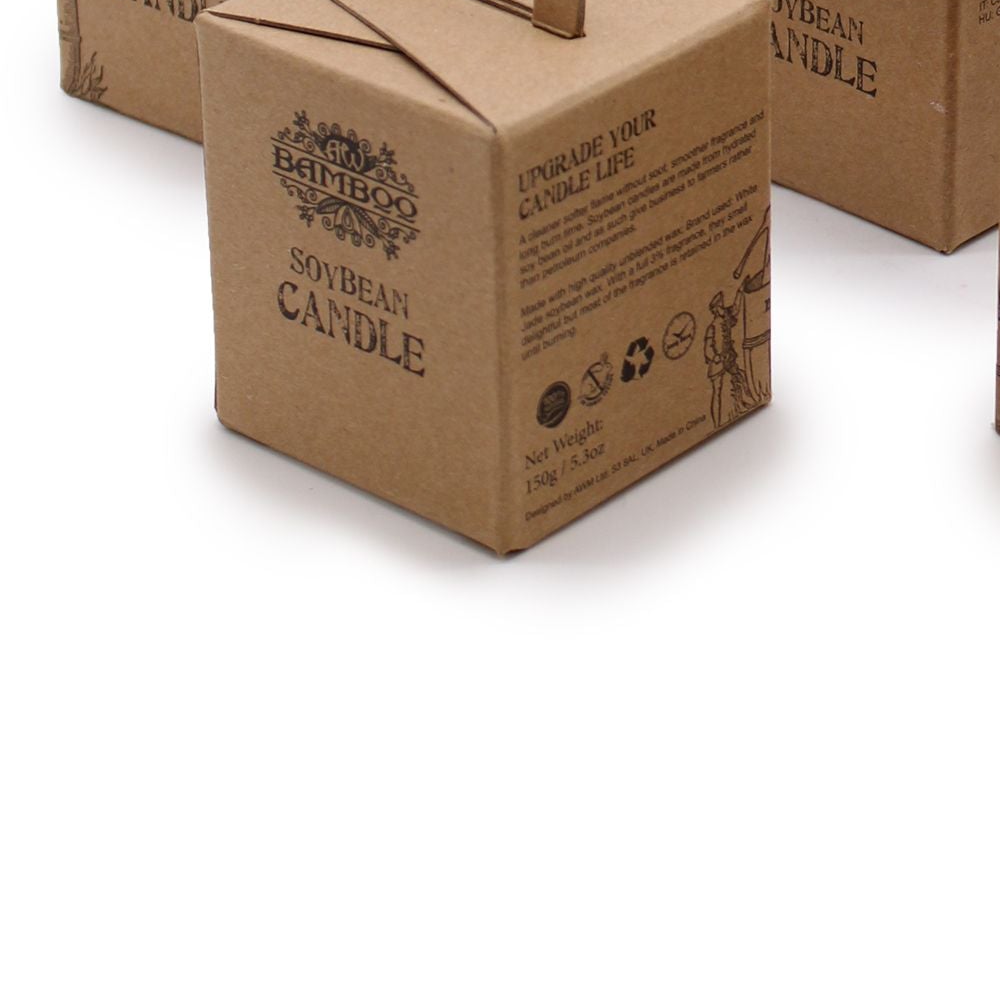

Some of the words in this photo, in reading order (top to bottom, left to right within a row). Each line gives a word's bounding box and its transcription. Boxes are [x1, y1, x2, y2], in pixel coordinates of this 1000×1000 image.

[770, 20, 877, 98] ANDLE
[272, 144, 418, 224] BAMBOO
[518, 133, 602, 195] UPGRADE
[609, 106, 656, 150] YOUR
[518, 166, 589, 222] CANDLE
[596, 145, 634, 183] LIFE
[290, 246, 408, 320] SOYBEAN
[277, 281, 425, 378] CANDLE
[525, 444, 547, 472] Net
[552, 412, 603, 460] Weight:
[526, 464, 557, 500] 150g
[570, 438, 604, 471] 5.3oz
